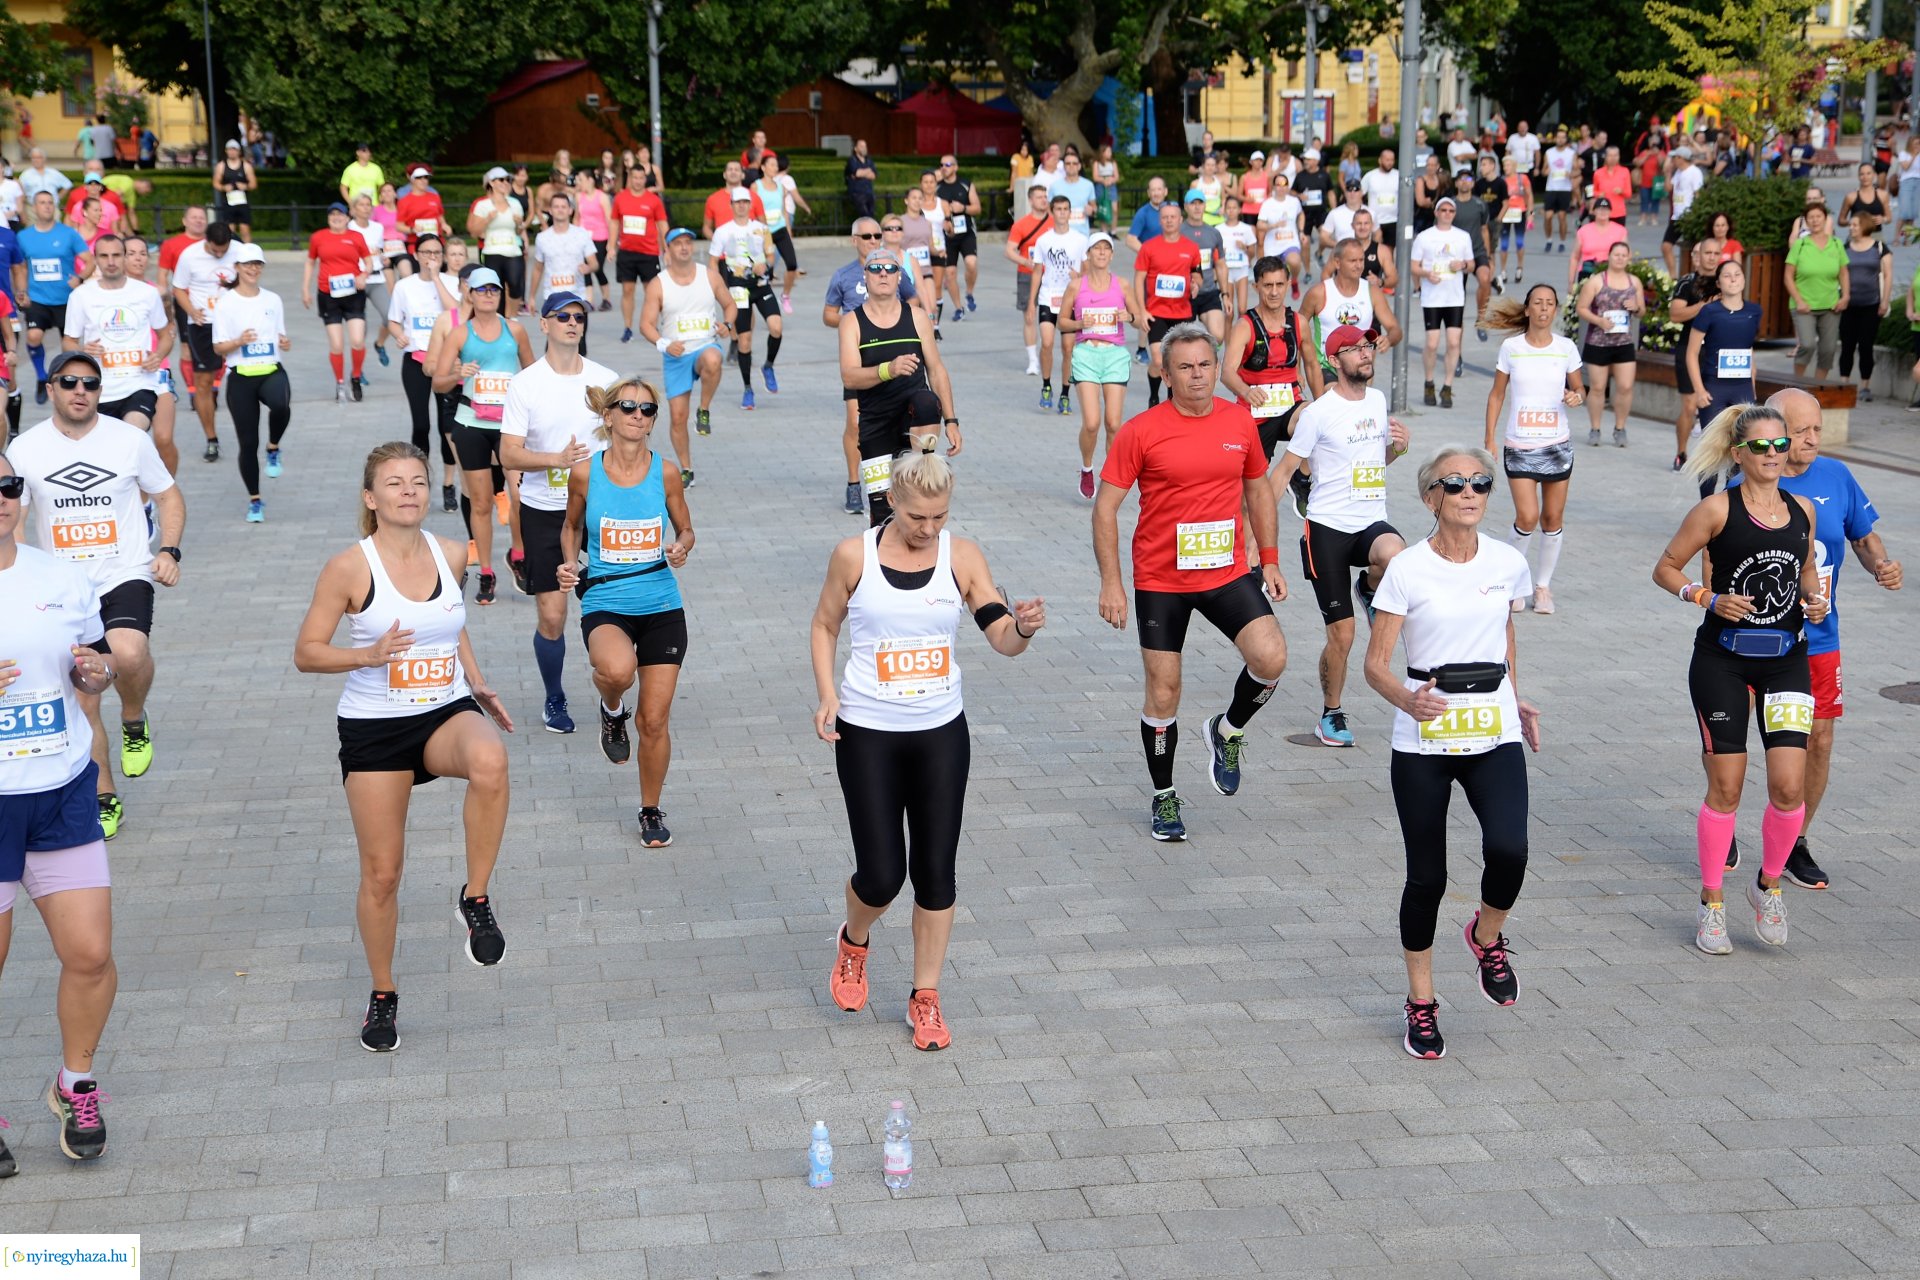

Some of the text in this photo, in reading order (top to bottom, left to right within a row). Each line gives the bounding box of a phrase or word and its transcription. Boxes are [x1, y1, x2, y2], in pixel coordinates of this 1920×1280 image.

[1160, 280, 1179, 291] 507
[246, 344, 271, 354] 609
[103, 352, 140, 364] 1019
[1726, 356, 1748, 366] 636
[1520, 412, 1555, 424] 1143
[551, 468, 571, 482] 21
[54, 494, 112, 508] umbro
[58, 522, 110, 542] 1099
[607, 529, 656, 545] 1094
[1184, 532, 1230, 550] 2150
[1733, 557, 1754, 578] NAKED
[1756, 550, 1795, 562] WARRIOR
[398, 658, 454, 681] 1058
[883, 650, 944, 673] 1059
[0, 703, 54, 731] 519
[1427, 710, 1494, 731] 2119
[1771, 704, 1813, 725] 213
